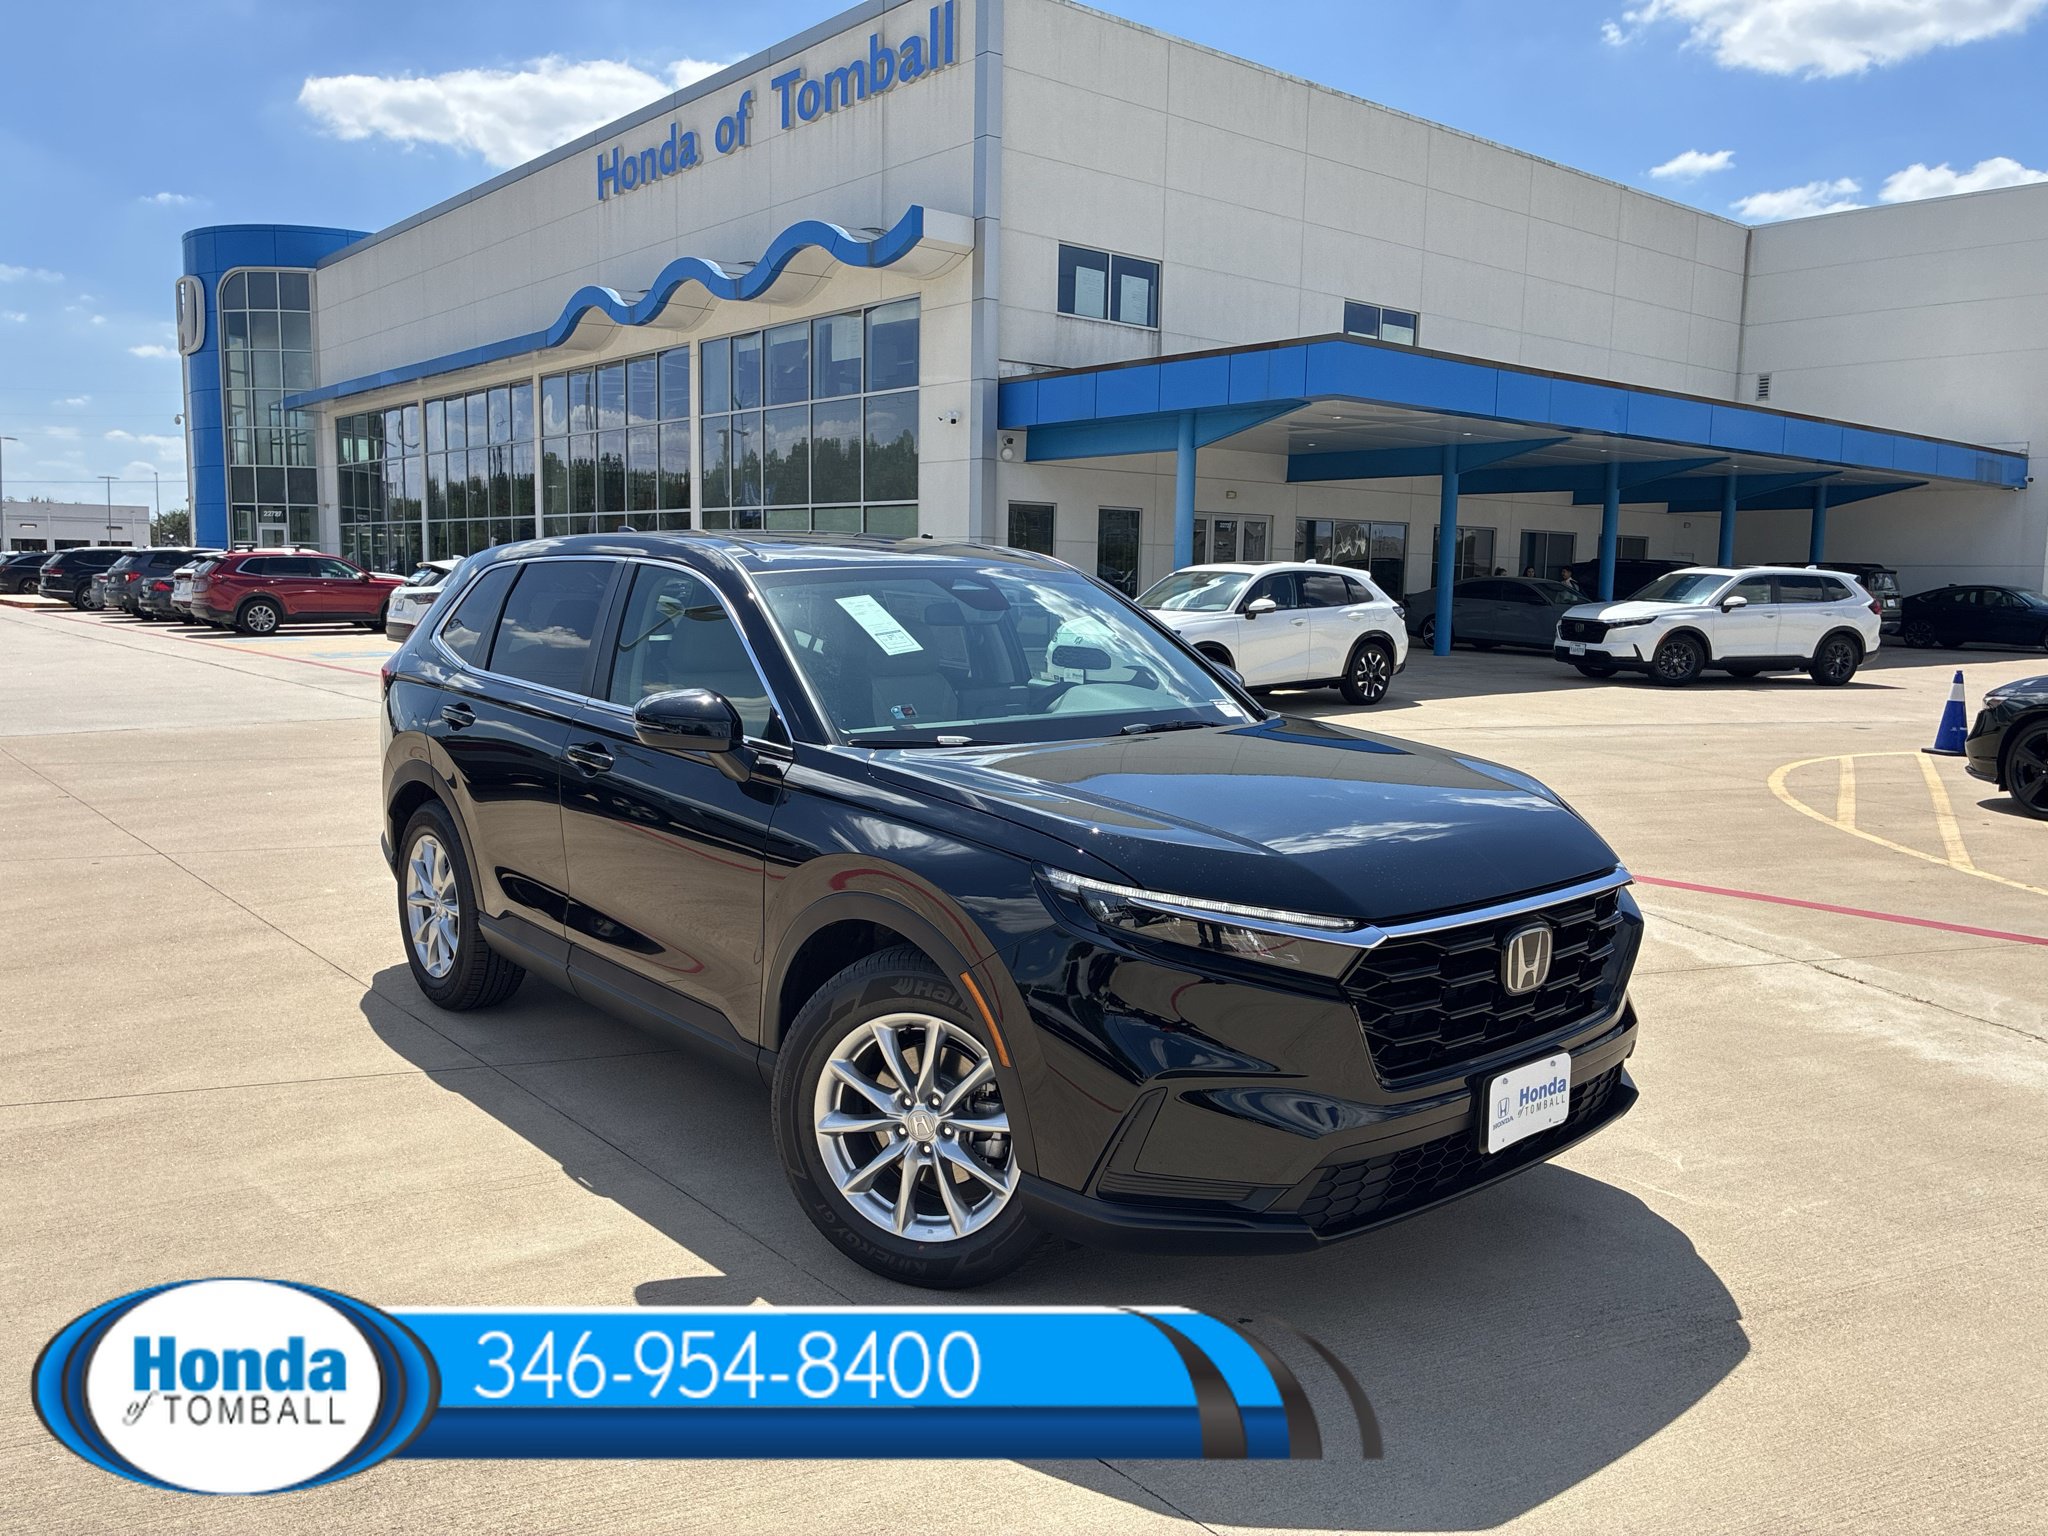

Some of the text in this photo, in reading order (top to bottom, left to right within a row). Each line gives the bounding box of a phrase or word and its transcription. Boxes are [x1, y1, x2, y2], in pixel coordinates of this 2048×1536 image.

[597, 0, 958, 201] Honda of Tomball
[1519, 1076, 1567, 1107] Honda
[1525, 1094, 1565, 1116] TOMBALL
[1492, 1115, 1514, 1130] HONDA
